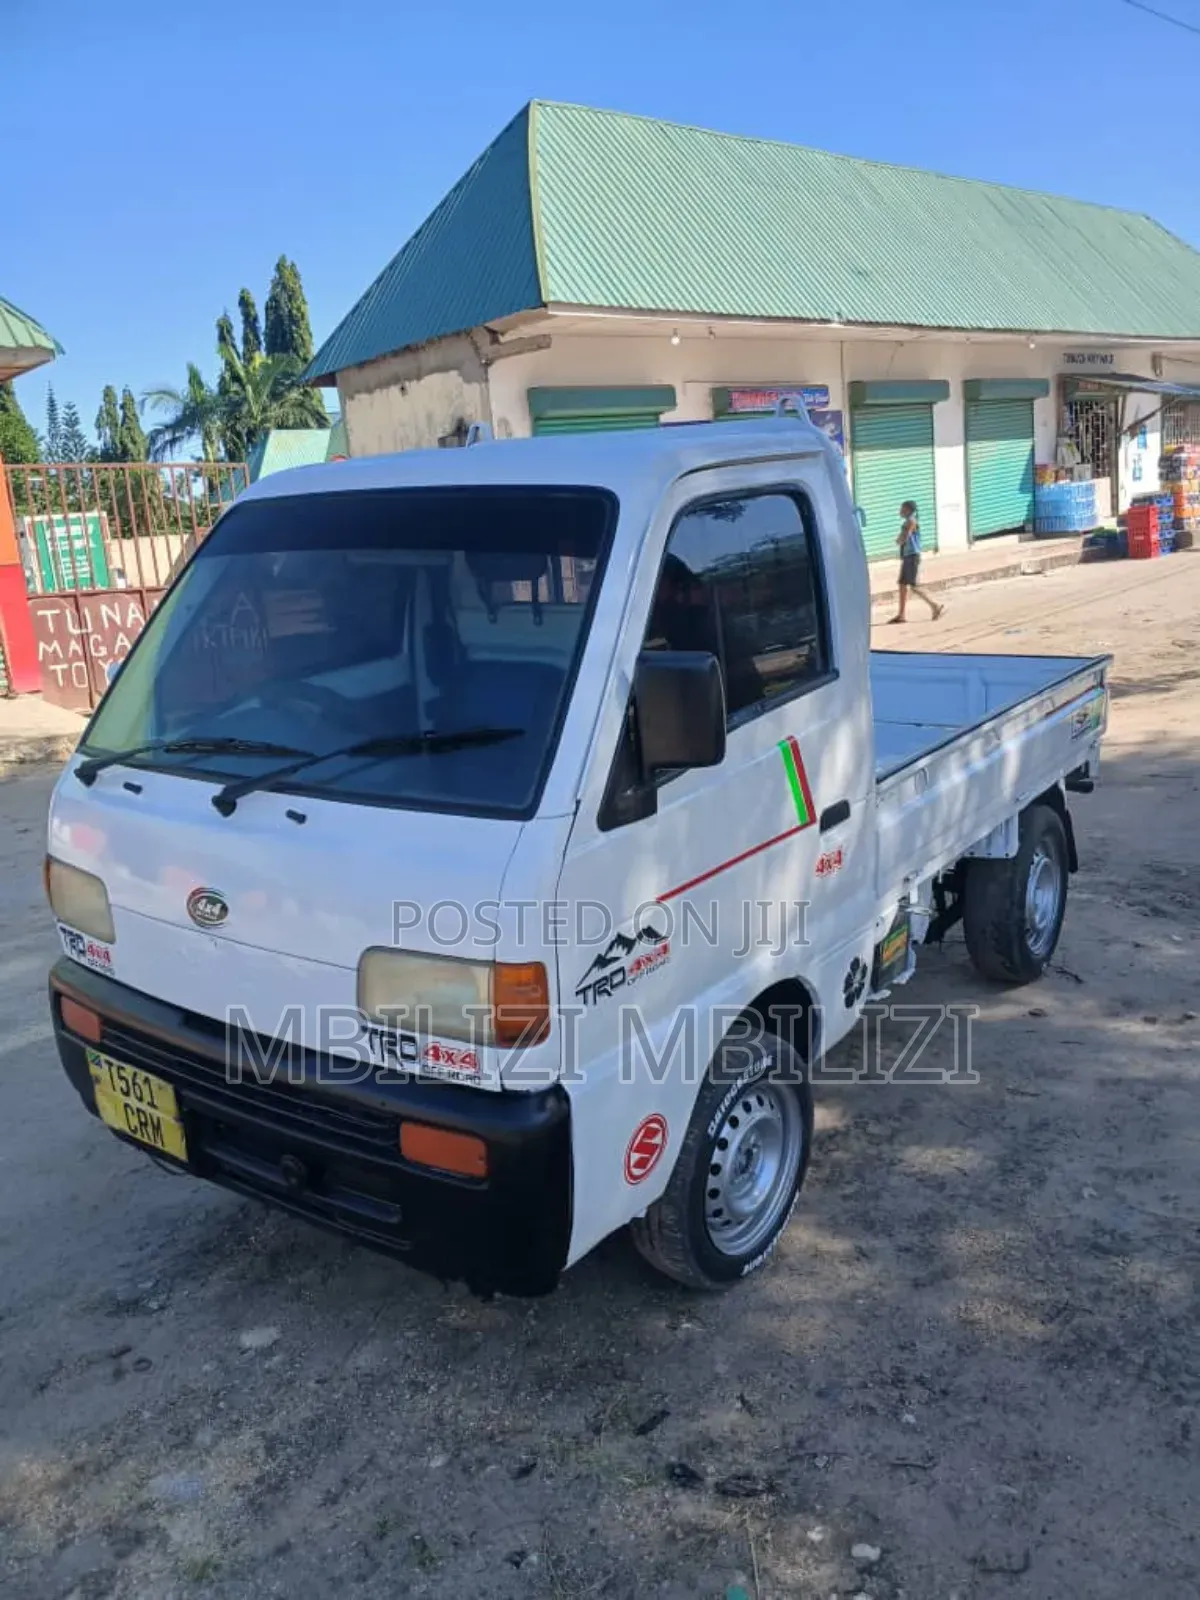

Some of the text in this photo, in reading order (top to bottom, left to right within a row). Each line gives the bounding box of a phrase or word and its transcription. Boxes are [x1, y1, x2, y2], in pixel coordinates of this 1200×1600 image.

[36, 602, 157, 635] TUNA
[575, 966, 627, 1005] TRD
[421, 1041, 481, 1073] 4x4
[104, 1059, 159, 1110] T561
[123, 1102, 165, 1149] CRM
